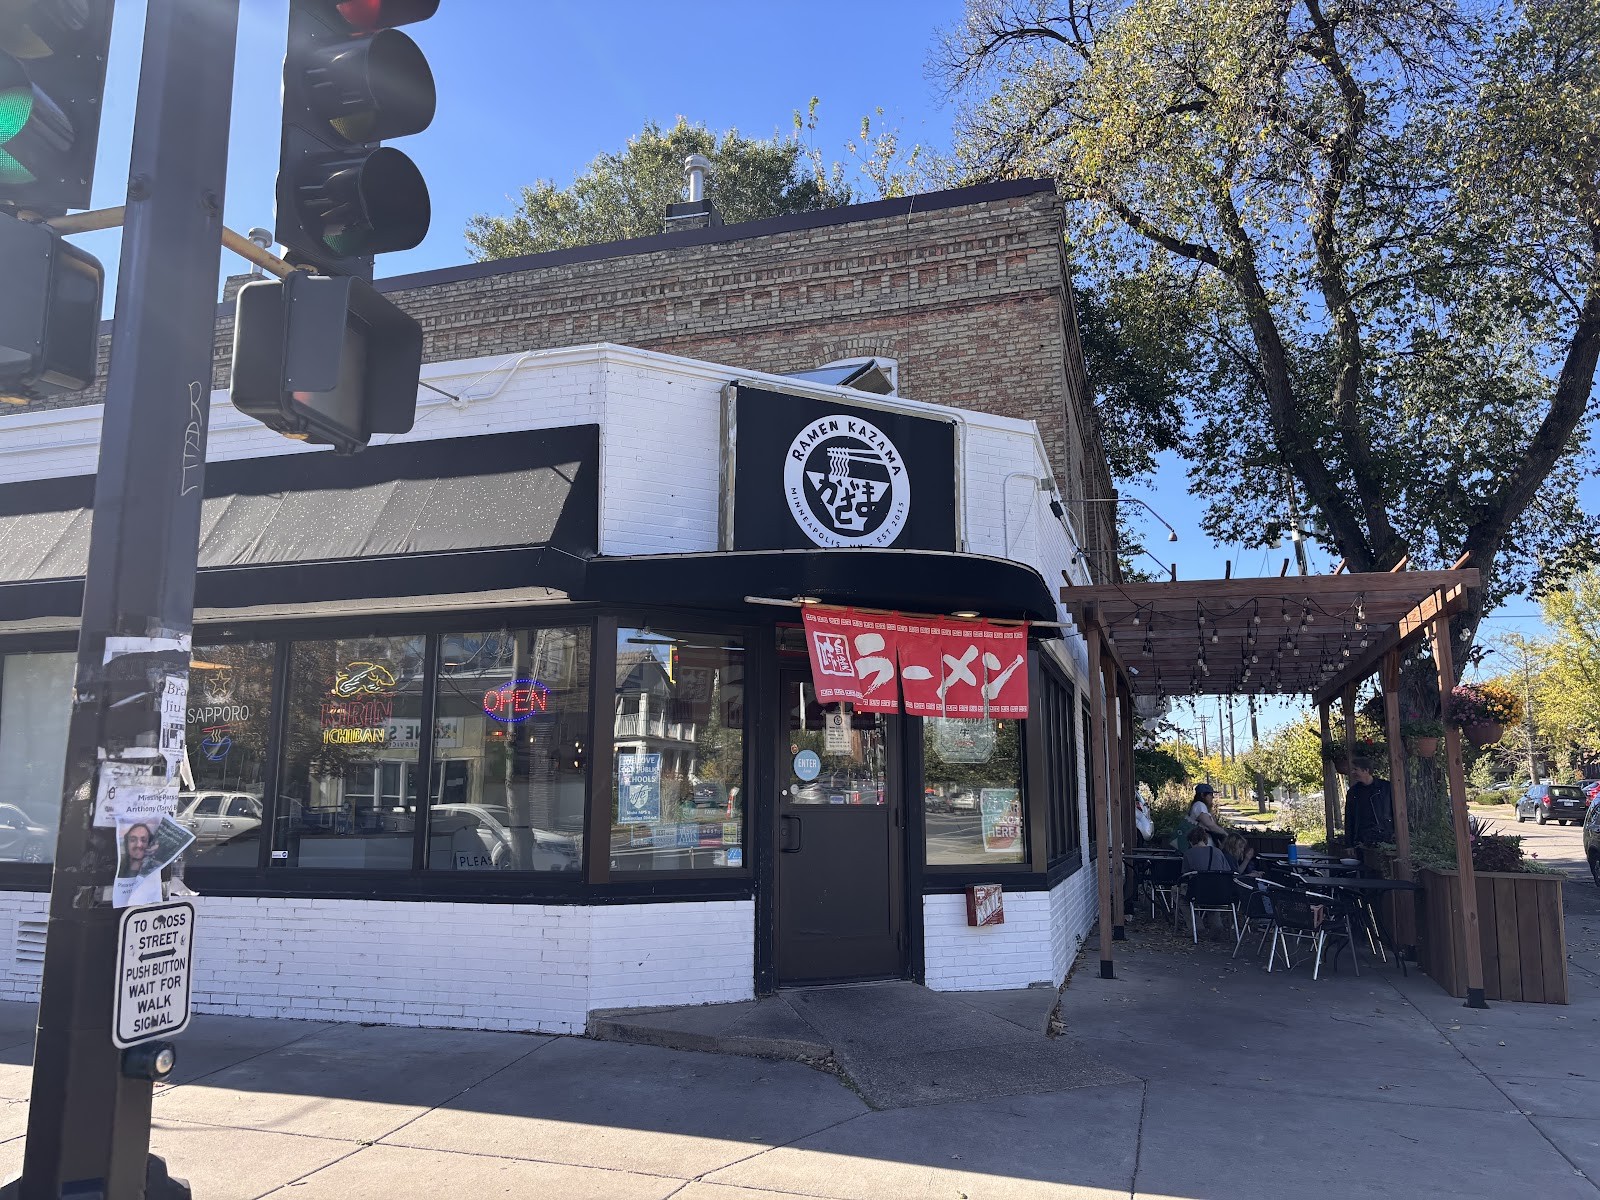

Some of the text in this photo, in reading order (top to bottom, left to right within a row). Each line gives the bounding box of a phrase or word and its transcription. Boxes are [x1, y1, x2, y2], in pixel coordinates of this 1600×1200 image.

[792, 420, 901, 476] RAMEN KAZAMA
[790, 487, 840, 548] MINNEAPOLIS
[876, 501, 905, 543] EST 2015
[854, 632, 1025, 700] ラーメン
[483, 689, 547, 712] OPEN
[187, 705, 250, 724] SAPPORO
[321, 701, 393, 728] KIRIN
[323, 728, 385, 744] ICHIBAN
[798, 758, 817, 768] ENTER
[623, 775, 657, 783] SCHOOLS
[987, 826, 1015, 838] HERE
[459, 855, 499, 867] PLEAS
[134, 913, 186, 934] TO CROSS
[138, 931, 179, 950] STREET
[126, 957, 186, 982] PUSH BUTTON
[129, 975, 181, 999] WAIT FOR
[137, 994, 172, 1014] WALK
[133, 1011, 174, 1033] SIGNAL
